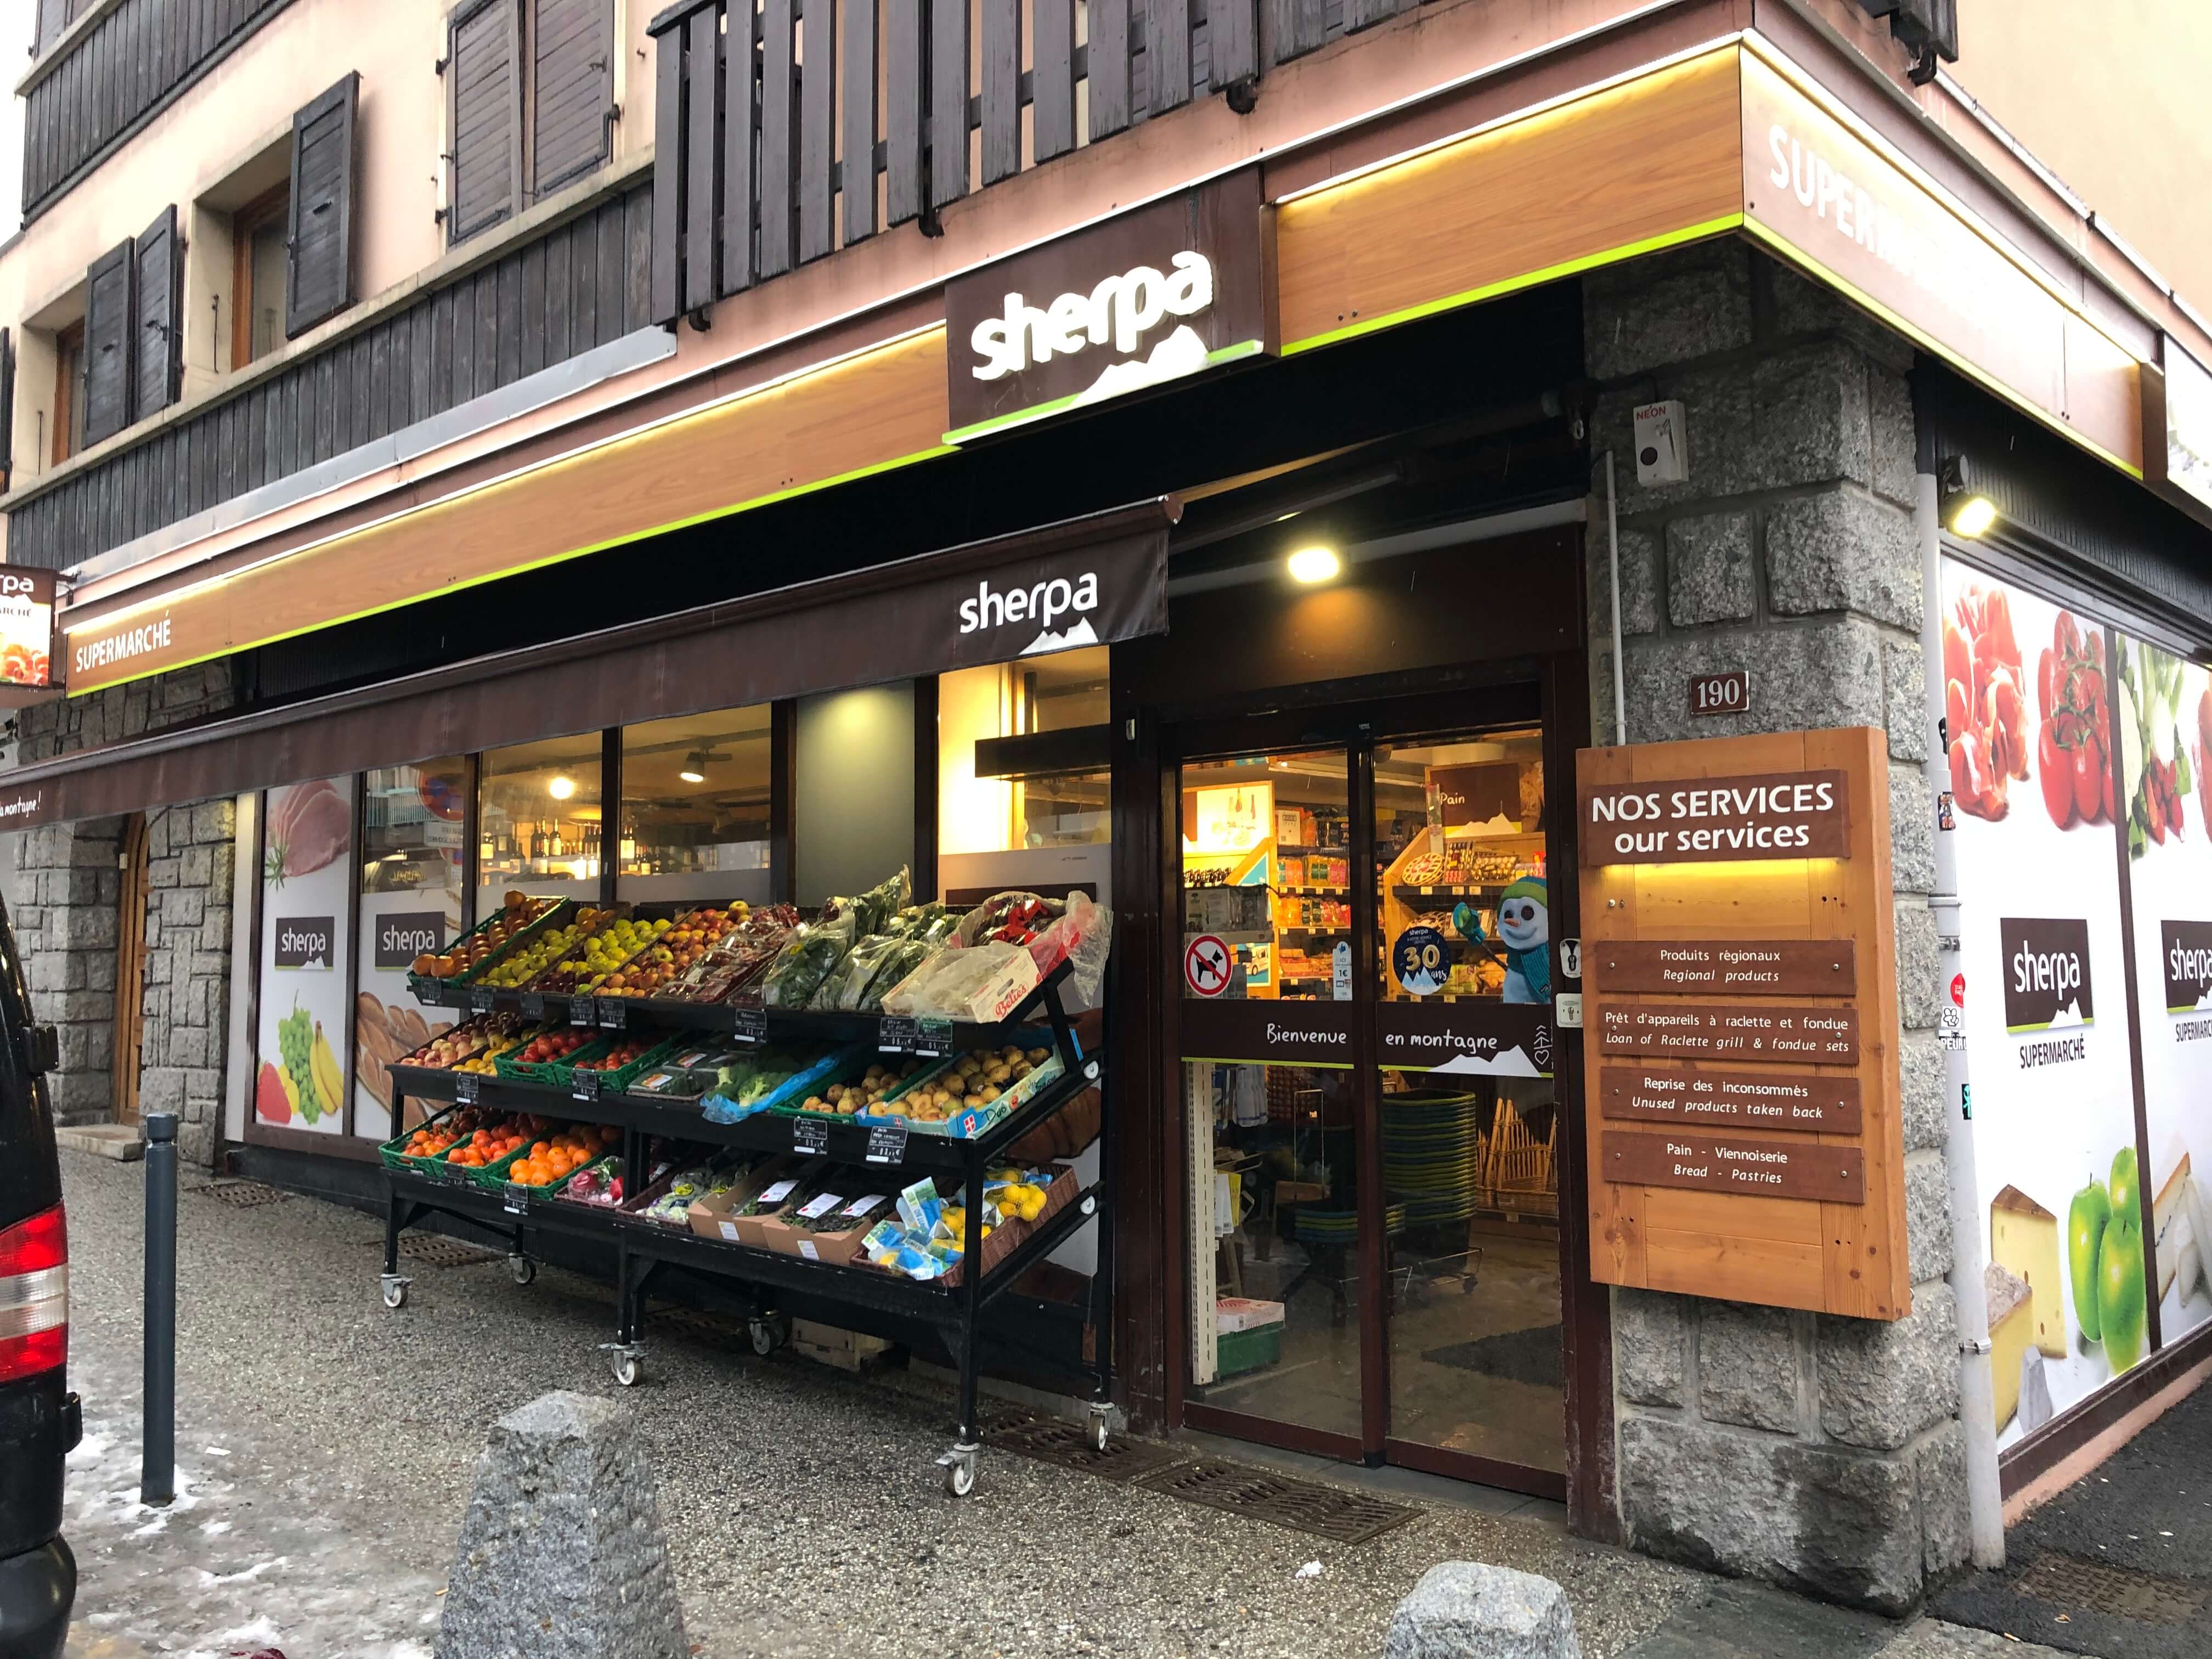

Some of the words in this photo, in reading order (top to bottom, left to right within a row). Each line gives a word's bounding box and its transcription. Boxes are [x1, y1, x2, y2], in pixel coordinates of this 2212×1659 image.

[970, 251, 1212, 380] sherpa
[960, 572, 1097, 634] sherpa
[76, 610, 171, 673] SUPERMARCHÉ
[1699, 679, 1740, 708] 190
[1440, 792, 1465, 805] Pain
[1592, 793, 1661, 822] NOS
[1671, 783, 1832, 818] SERVICES
[1615, 831, 1669, 853] our
[1677, 821, 1809, 852] services
[281, 928, 326, 957] sherpa
[383, 925, 435, 955] sherpa
[1404, 944, 1440, 971] 30
[1661, 949, 1709, 961] Produits
[1719, 949, 1780, 964] régionaux
[2013, 940, 2081, 1000] sherpa
[1431, 970, 1447, 981] ans
[1663, 969, 1714, 983] Regional
[1725, 970, 1779, 983] products
[1606, 1012, 1628, 1024] Prêt
[1637, 1013, 1700, 1028] d'appareils
[1709, 1014, 1716, 1026] à
[1725, 1015, 1771, 1028] raclette
[1780, 1017, 1792, 1028] et
[1803, 1016, 1848, 1030] fondue
[2176, 1019, 2212, 1042] SUPERMARC
[1267, 1023, 1347, 1044] Bienvenue
[1386, 1032, 1404, 1045] en
[1410, 1029, 1498, 1054] montagne
[1606, 1032, 1633, 1045] Loan
[1641, 1034, 1651, 1045] of
[1661, 1034, 1708, 1047] Raclette
[1716, 1036, 1743, 1050] grill
[1753, 1037, 1762, 1048] &
[1772, 1037, 1816, 1051] fondue
[1826, 1040, 1848, 1052] sets
[2020, 1034, 2085, 1069] SUPERMARCHÉ
[1644, 1077, 1685, 1093] Reprise
[1693, 1080, 1713, 1092] des
[1723, 1081, 1808, 1097] inconsommés
[1632, 1097, 1675, 1110] Unused
[1685, 1100, 1737, 1115] products
[1747, 1103, 1783, 1116] taken
[1793, 1105, 1822, 1119] back
[1667, 1143, 1692, 1156] Pain
[1715, 1147, 1787, 1164] Viennoiserie
[1674, 1164, 1707, 1178] Bread
[1732, 1169, 1781, 1184] Pastries
